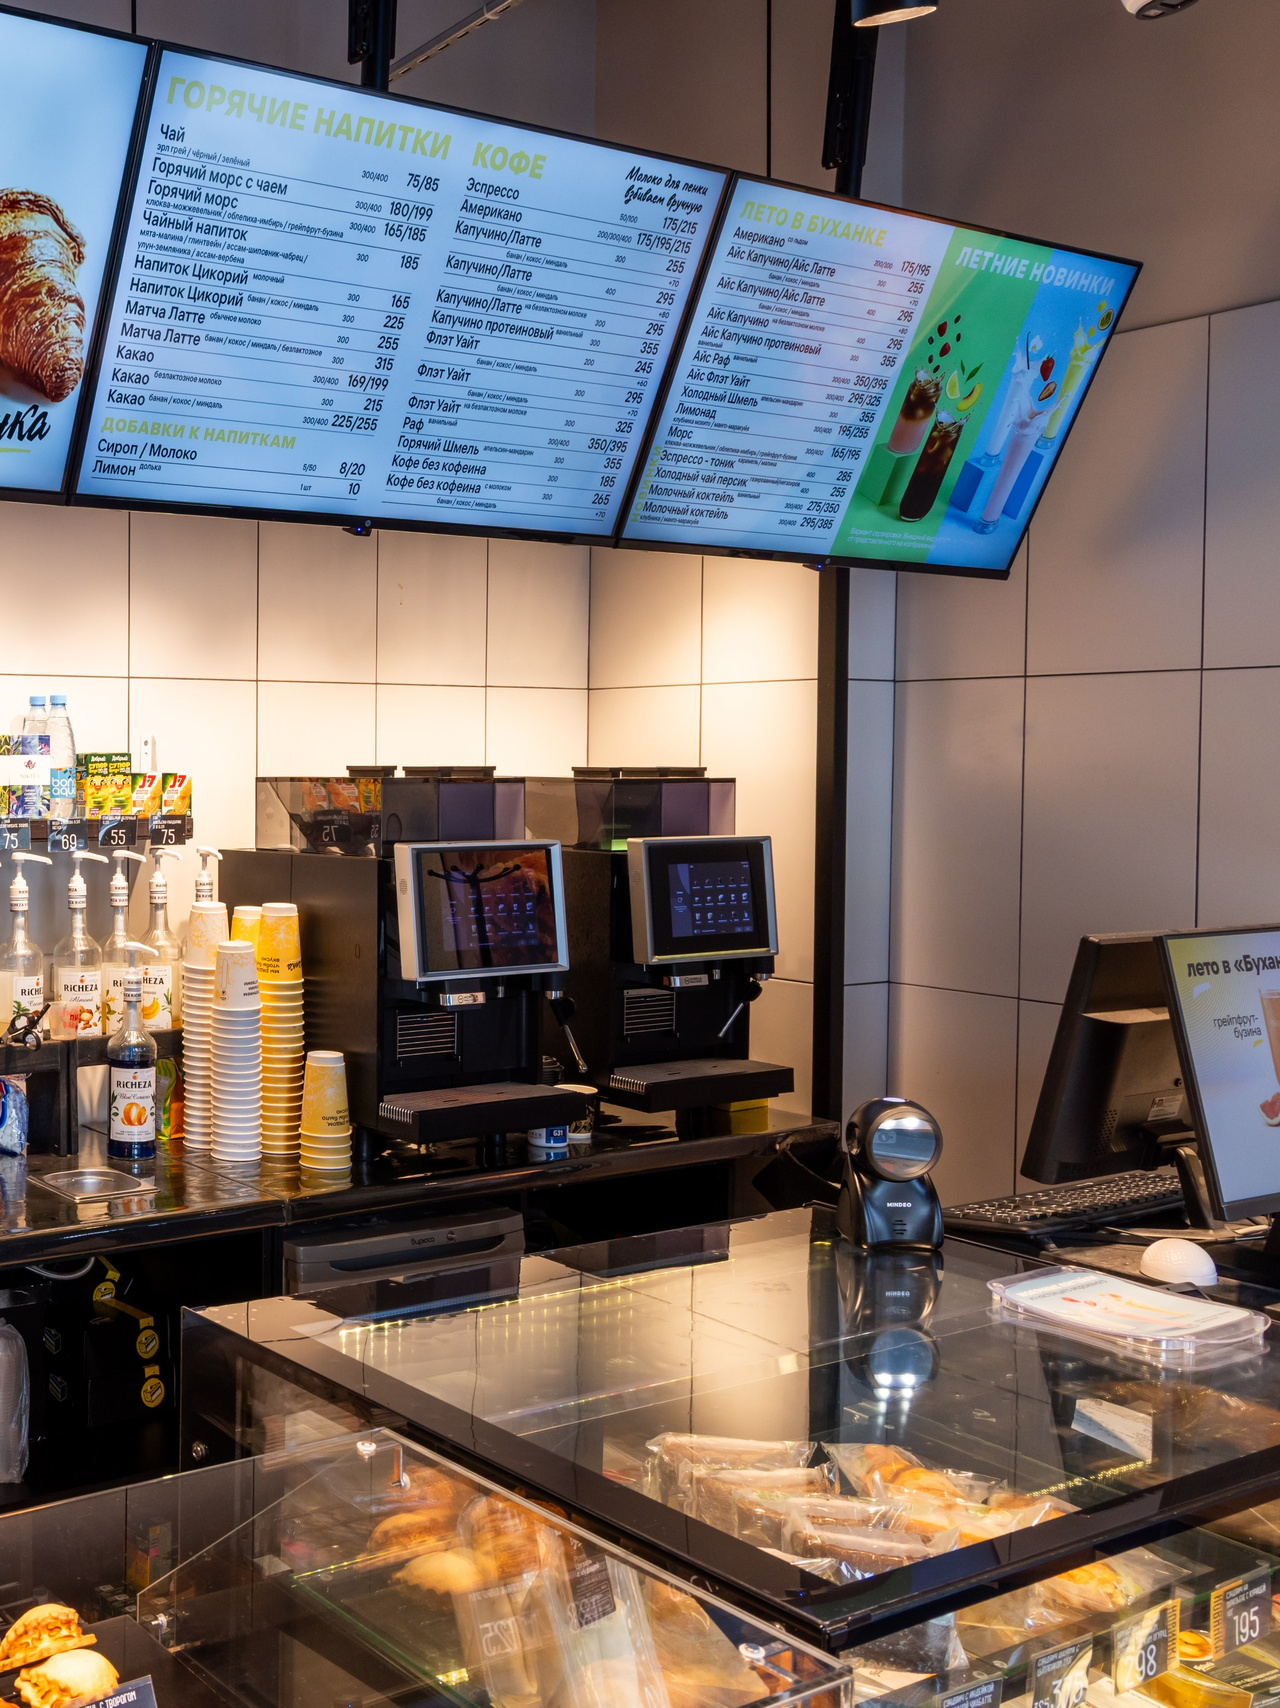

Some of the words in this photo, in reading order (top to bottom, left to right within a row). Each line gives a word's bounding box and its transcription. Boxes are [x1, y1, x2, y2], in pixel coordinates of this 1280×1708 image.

[160, 124, 185, 142] Чай
[166, 76, 309, 131] ГОРЯЧИЕ
[313, 104, 452, 160] НАПИТКИ
[152, 157, 207, 180] Горячий
[209, 170, 243, 188] морс
[245, 178, 253, 188] с
[256, 180, 288, 196] чаем
[472, 142, 547, 179] КОФЕ
[361, 170, 389, 183] 300/400
[407, 173, 439, 192] 75/85
[624, 184, 665, 205] взбиваем
[668, 193, 703, 215] вручную
[625, 166, 663, 186] Молоко
[664, 174, 681, 192] для
[682, 181, 709, 196] пенки
[389, 201, 433, 222] 180/199
[466, 177, 520, 200] Эспрессо
[662, 217, 698, 235] 175/215
[740, 201, 788, 227] ЛЕТО
[791, 213, 805, 229] В
[806, 215, 888, 248] БУХАНКЕ
[143, 210, 193, 231] Чайный
[196, 224, 248, 242] напиток
[400, 255, 419, 270] 185
[460, 198, 522, 222] Американо
[636, 232, 692, 255] 175/195/215
[455, 220, 542, 249] Капучино/Латте
[665, 259, 685, 274] 255
[733, 226, 785, 248] Американо
[901, 261, 932, 278] 175/195
[134, 254, 190, 276] Напиток
[192, 263, 248, 285] Цикорий
[391, 294, 410, 309] 165
[727, 246, 746, 260] Айс
[746, 250, 809, 276] Капучино/Айс
[810, 262, 836, 277] Латте
[907, 281, 925, 295] 255
[955, 245, 1029, 279] ЛЕТНИЕ
[1029, 263, 1117, 297] НОВИНКИ
[125, 300, 165, 319] Матча
[167, 306, 205, 324] Латте
[378, 336, 399, 351] 255
[431, 310, 484, 331] Капучино
[484, 319, 554, 341] протеиновый
[640, 341, 659, 356] 355
[426, 331, 455, 348] Флэт
[455, 334, 480, 350] Уайт
[635, 360, 653, 375] 245
[111, 368, 150, 385] Какао
[363, 398, 383, 413] 215
[107, 389, 145, 406] Какао
[302, 416, 329, 426] 300/400
[331, 414, 378, 431] 225/255
[675, 403, 716, 420] Лимонад
[838, 425, 871, 439] 195/255
[101, 417, 184, 439] ДОБАВКИ
[189, 426, 202, 439] К
[203, 427, 296, 449] НАПИТКАМ
[402, 416, 424, 433] Раф
[587, 437, 628, 454] 350/395
[97, 439, 138, 457] Сироп
[148, 446, 197, 461] Молоко
[339, 461, 366, 477] 8/20
[391, 454, 420, 471] Кофе
[421, 457, 440, 471] без
[441, 460, 487, 476] кофеина
[599, 475, 616, 488] 185
[397, 435, 442, 453] Горячий
[443, 440, 479, 456] Шмель
[603, 457, 622, 471] 355
[92, 459, 136, 476] Лимон
[348, 483, 361, 495] 10
[631, 445, 663, 523] НОВИНКИ
[642, 501, 689, 517] Молочный
[690, 506, 729, 521] коктейль
[799, 517, 834, 530] 295/385
[138, 774, 156, 789] J7
[169, 774, 187, 789] J7
[3, 833, 19, 849] 75
[61, 834, 77, 850] 69
[110, 829, 126, 845] 55
[161, 829, 175, 844] 75
[1187, 961, 1220, 978] лето
[1222, 960, 1231, 974] в
[1213, 1014, 1258, 1030] грейпфрут-
[1233, 1027, 1262, 1040] бузина
[1213, 1593, 1223, 1654] НОВИНКА
[1233, 1606, 1260, 1646] 195
[1124, 1644, 1157, 1688] 298
